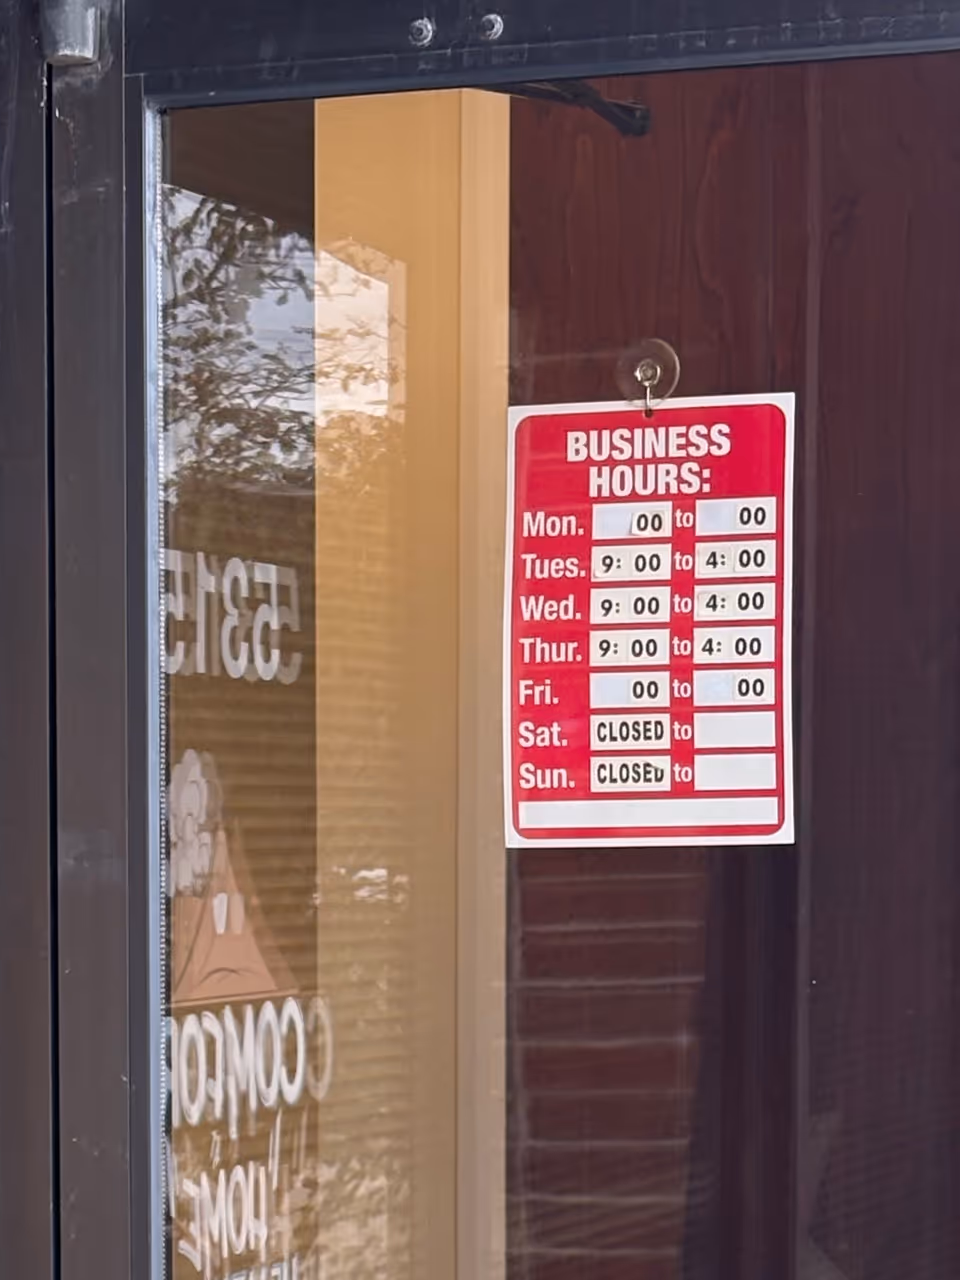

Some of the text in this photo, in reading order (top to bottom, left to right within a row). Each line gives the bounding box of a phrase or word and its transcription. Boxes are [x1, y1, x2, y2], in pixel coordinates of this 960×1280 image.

[567, 423, 732, 462] BUSINESS
[589, 462, 711, 497] HOURS:
[522, 506, 767, 538] Mon. 00 to 00
[521, 553, 586, 580] Tues.
[674, 551, 693, 571] to
[519, 594, 582, 621] Wed.
[673, 594, 692, 613] to
[518, 637, 582, 664] Thur.
[672, 637, 691, 655] to
[518, 678, 765, 705] Fri. 00 to 00
[518, 720, 692, 747] Sat. CLOSED to
[519, 762, 693, 789] Sun. CLOSED to
